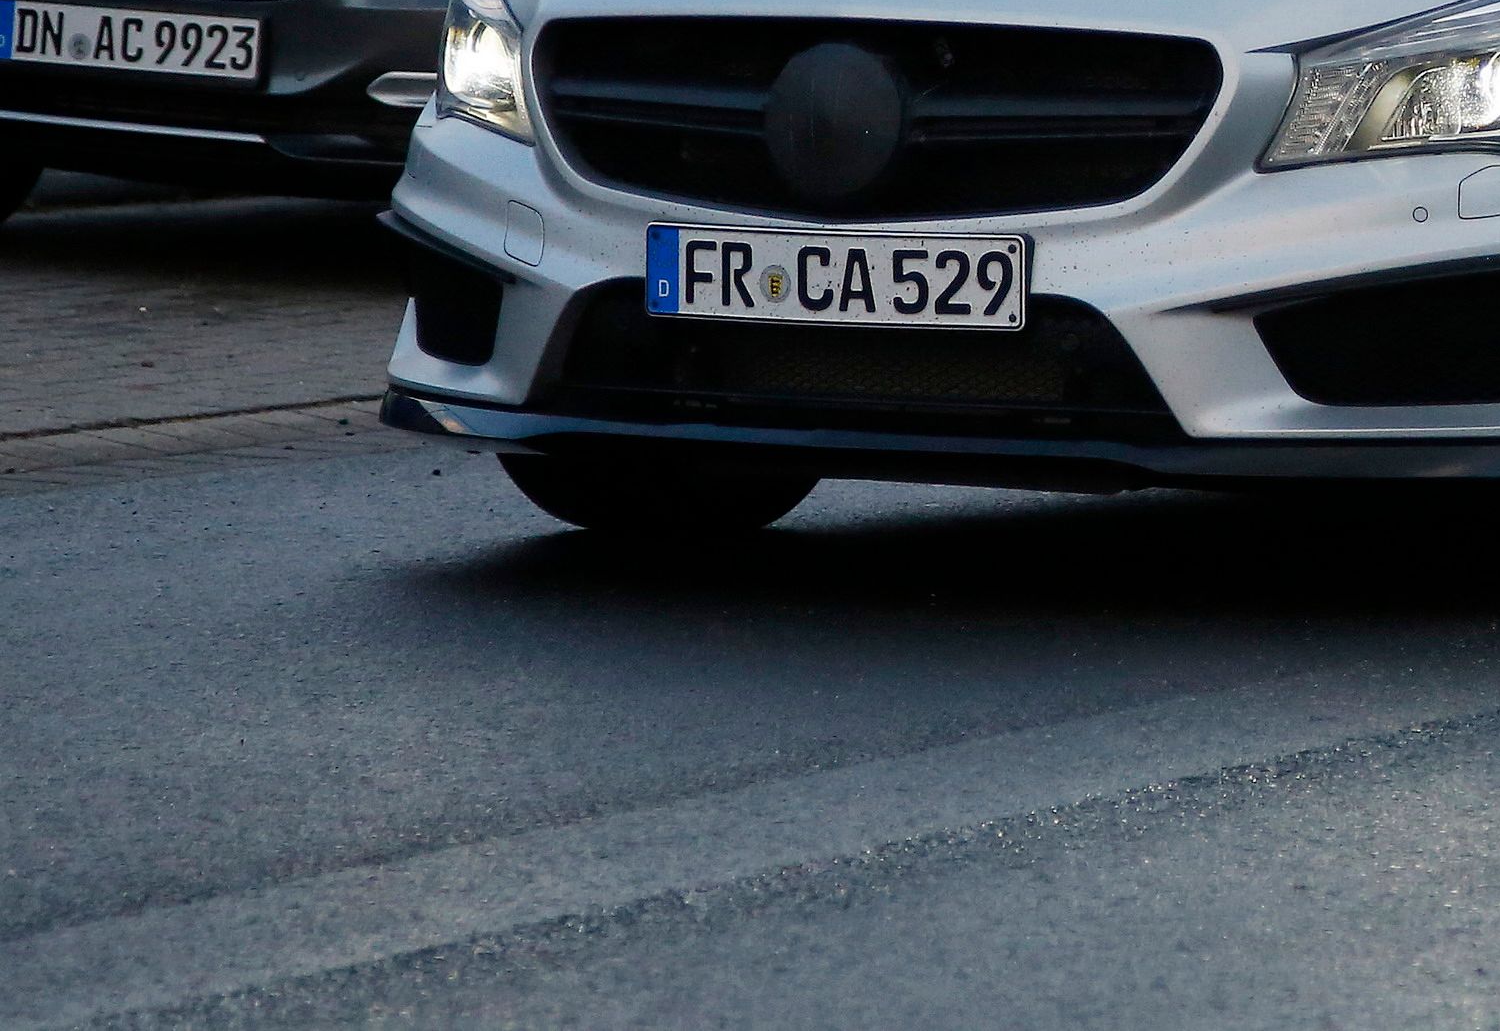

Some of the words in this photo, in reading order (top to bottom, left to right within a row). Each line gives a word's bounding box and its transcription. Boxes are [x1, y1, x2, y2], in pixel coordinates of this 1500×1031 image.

[15, 8, 64, 56] DN
[93, 16, 143, 63] AC
[155, 20, 256, 71] 9923
[685, 239, 755, 308] FR
[797, 245, 876, 313] CA
[892, 249, 1014, 316] 529
